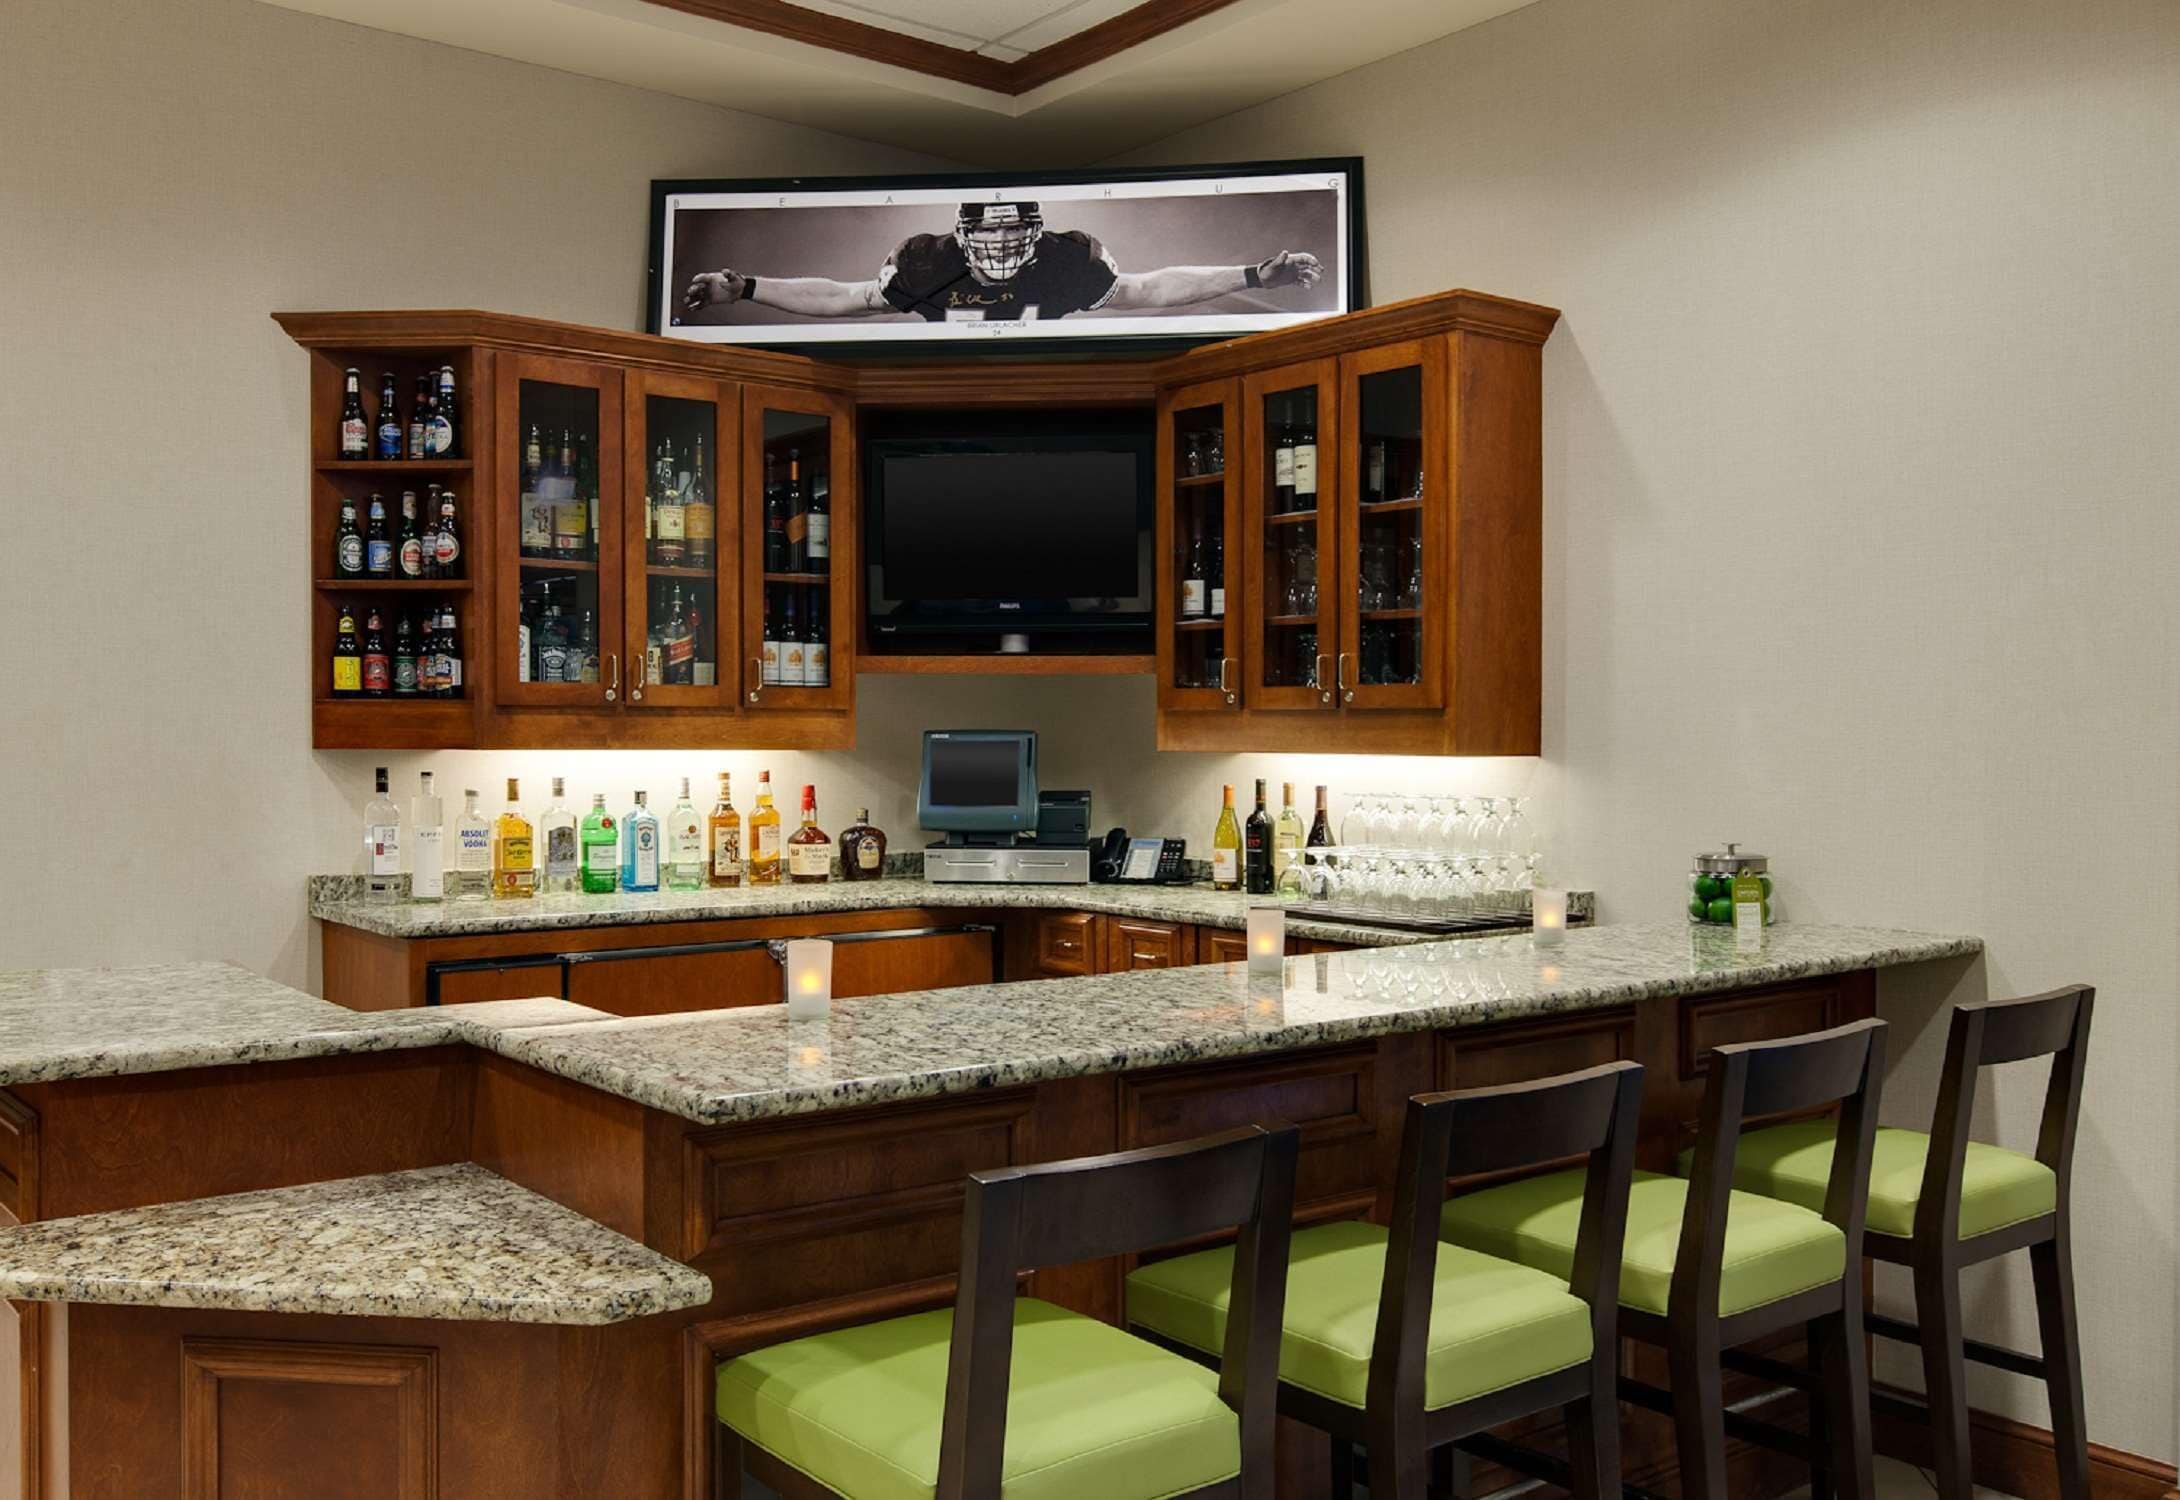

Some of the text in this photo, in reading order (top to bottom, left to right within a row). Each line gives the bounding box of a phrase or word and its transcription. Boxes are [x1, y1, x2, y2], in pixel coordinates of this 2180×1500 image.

[673, 198, 680, 209] B
[779, 197, 785, 207] E
[885, 195, 894, 204] A
[1104, 188, 1111, 198] H
[1216, 183, 1223, 193] U
[1328, 178, 1339, 188] G
[464, 840, 487, 848] VODKA
